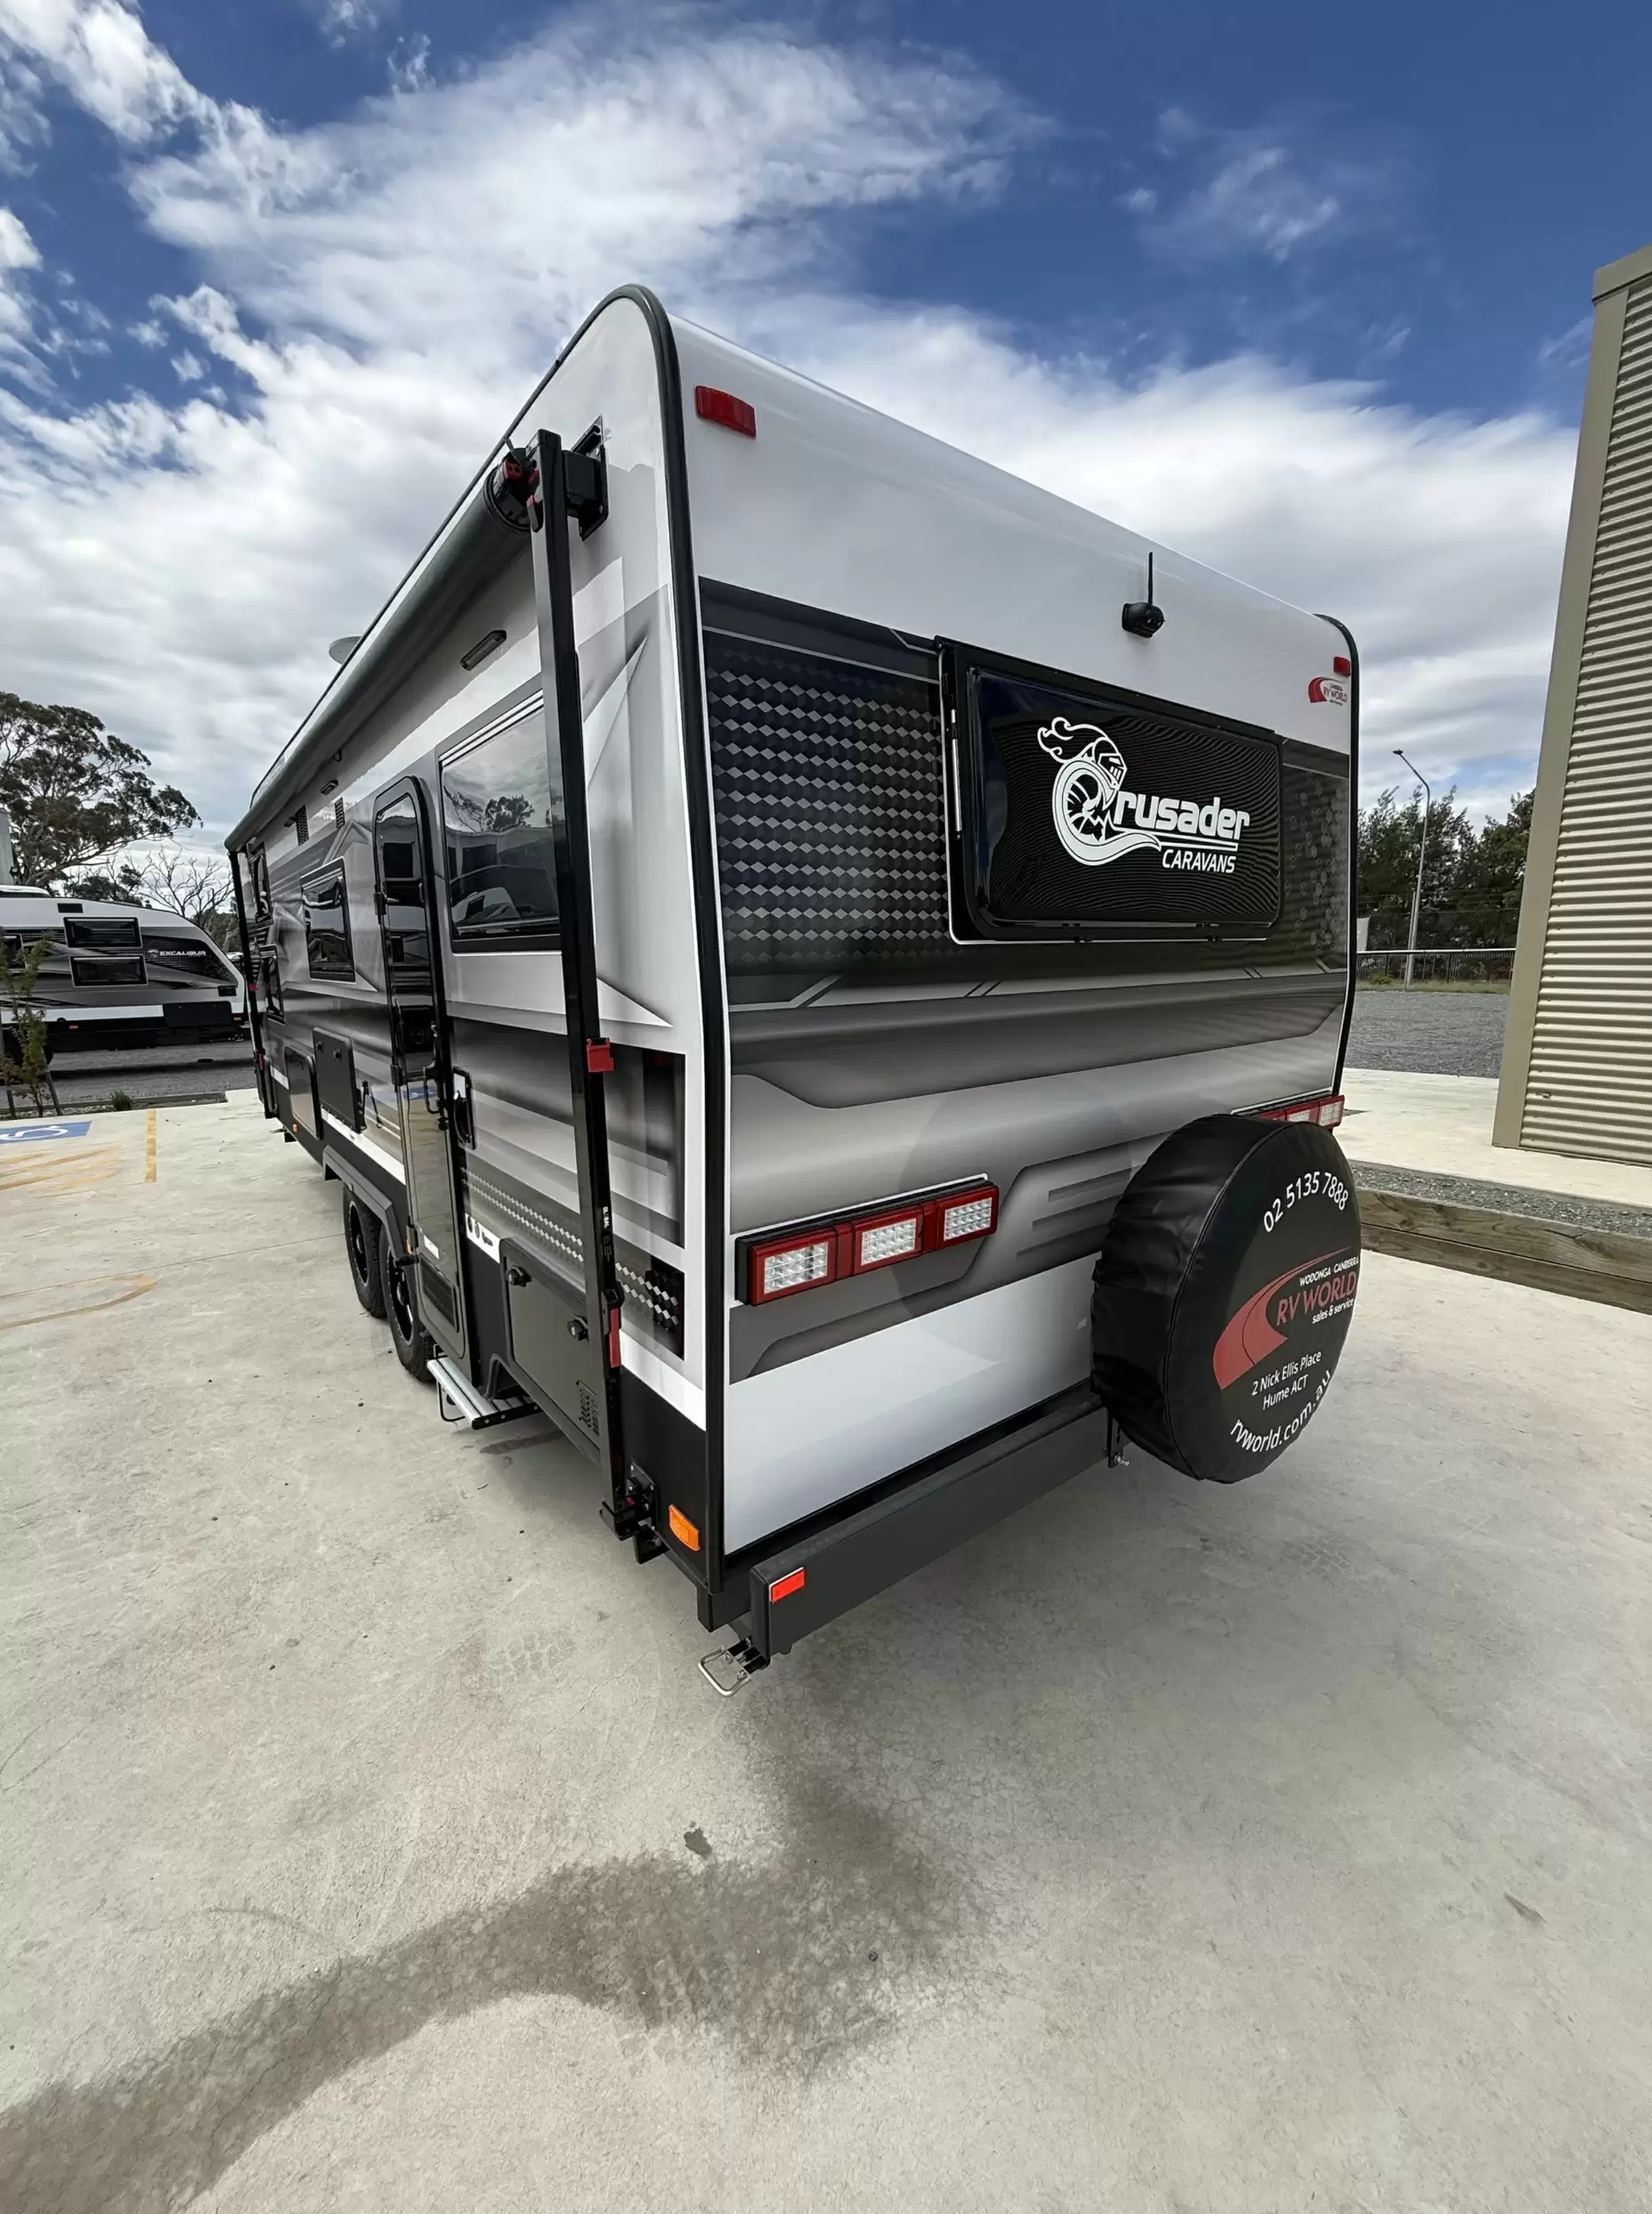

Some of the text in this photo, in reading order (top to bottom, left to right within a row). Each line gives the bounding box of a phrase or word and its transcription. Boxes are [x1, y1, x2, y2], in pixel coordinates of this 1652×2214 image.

[1330, 689, 1348, 702] WORLD
[1162, 849, 1236, 873] CARAVANS
[1264, 1171, 1348, 1233] 02 5135 7888
[1300, 1255, 1359, 1286] WODONGA CANBERRA
[1276, 1270, 1357, 1326] RV WORLD
[1312, 1298, 1354, 1325] sales & service
[1251, 1350, 1322, 1396] 2 Nick Ellis Place
[1262, 1374, 1308, 1410] Hume ACT
[1230, 1370, 1331, 1453] rvworld.com.au
